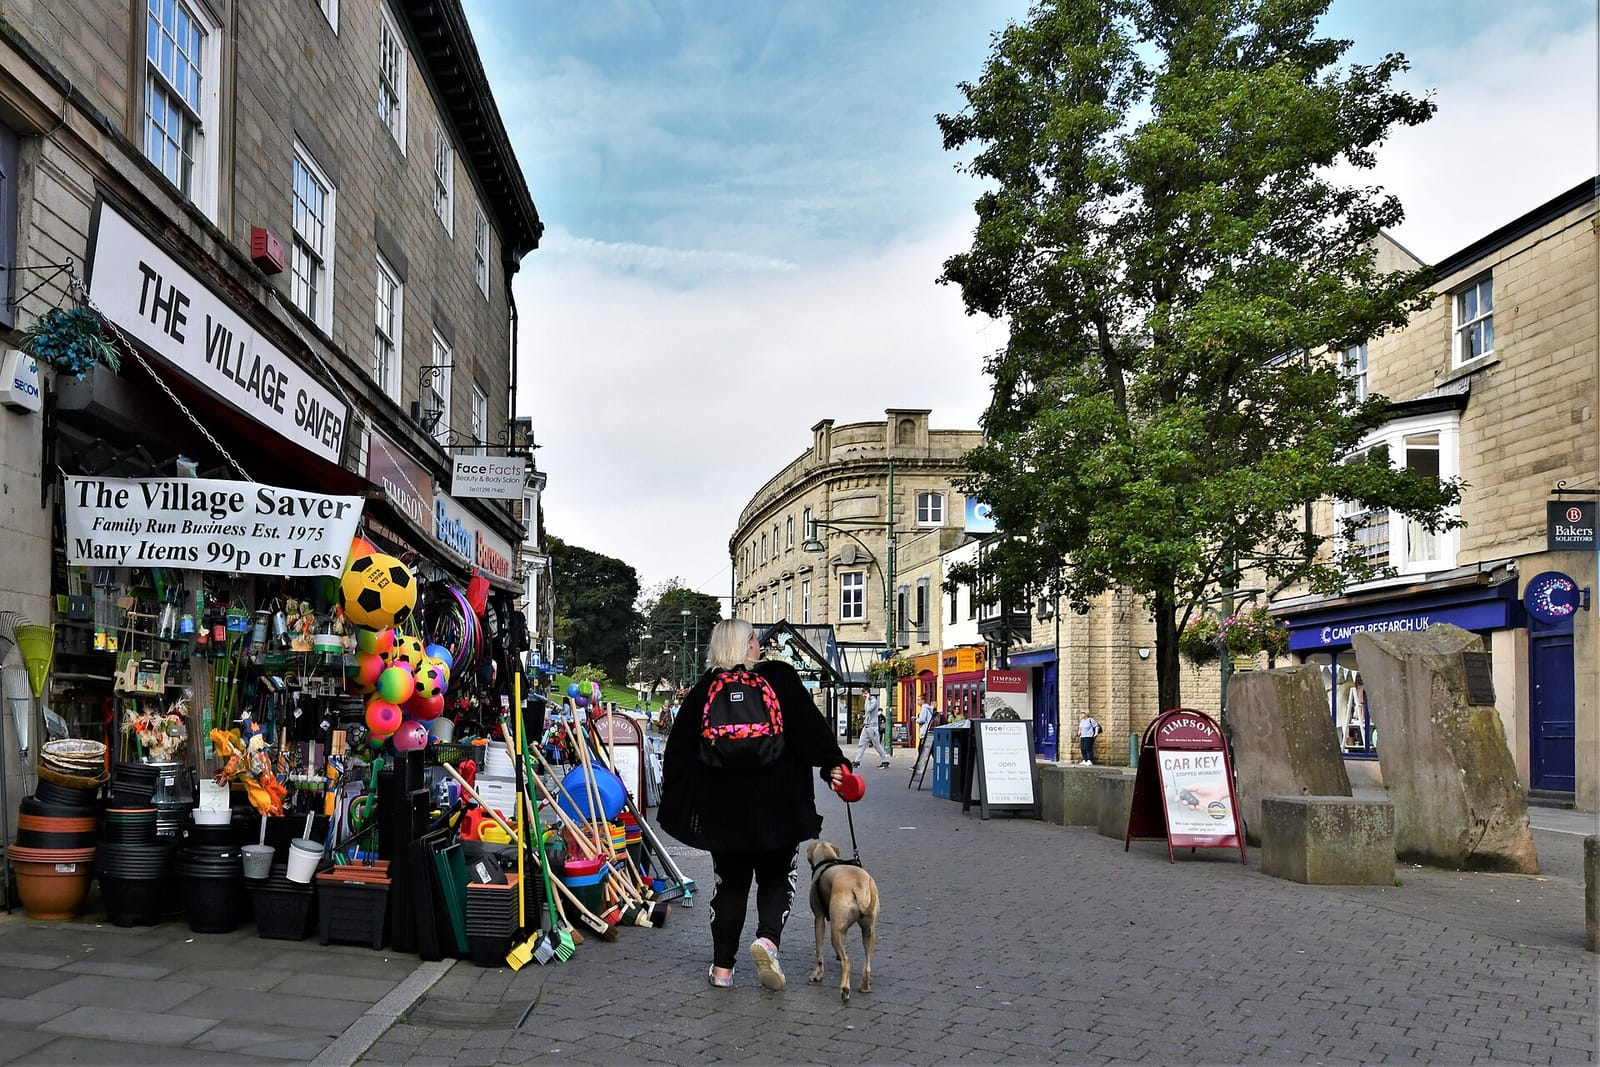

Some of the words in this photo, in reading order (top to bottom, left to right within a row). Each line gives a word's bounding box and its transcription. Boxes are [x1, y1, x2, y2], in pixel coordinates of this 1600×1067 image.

[137, 260, 191, 345] THE
[205, 313, 288, 415] VILLAGE
[294, 388, 342, 453] SAVER
[14, 378, 39, 398] SECOM
[456, 463, 486, 474] Face
[488, 464, 521, 475] Facts
[486, 476, 500, 484] Body
[74, 480, 129, 509] The
[138, 481, 245, 519] Village
[255, 487, 352, 521] Saver
[1570, 510, 1579, 520] B
[92, 516, 142, 536] Family
[148, 518, 176, 534] Run
[181, 520, 247, 537] Business
[251, 522, 280, 539] Est.
[287, 525, 325, 541] 1975
[436, 500, 473, 560] Buxton
[1555, 525, 1593, 536] Bakers
[74, 538, 131, 564] Many
[136, 540, 199, 562] Items
[207, 541, 251, 570] 99p
[258, 549, 285, 569] or
[293, 548, 342, 570] Less
[1368, 619, 1413, 633] RESEARCH
[1415, 616, 1430, 631] UK
[1161, 718, 1214, 737] TIMPSON
[1164, 757, 1190, 771] CAR
[1195, 755, 1219, 769] KEY
